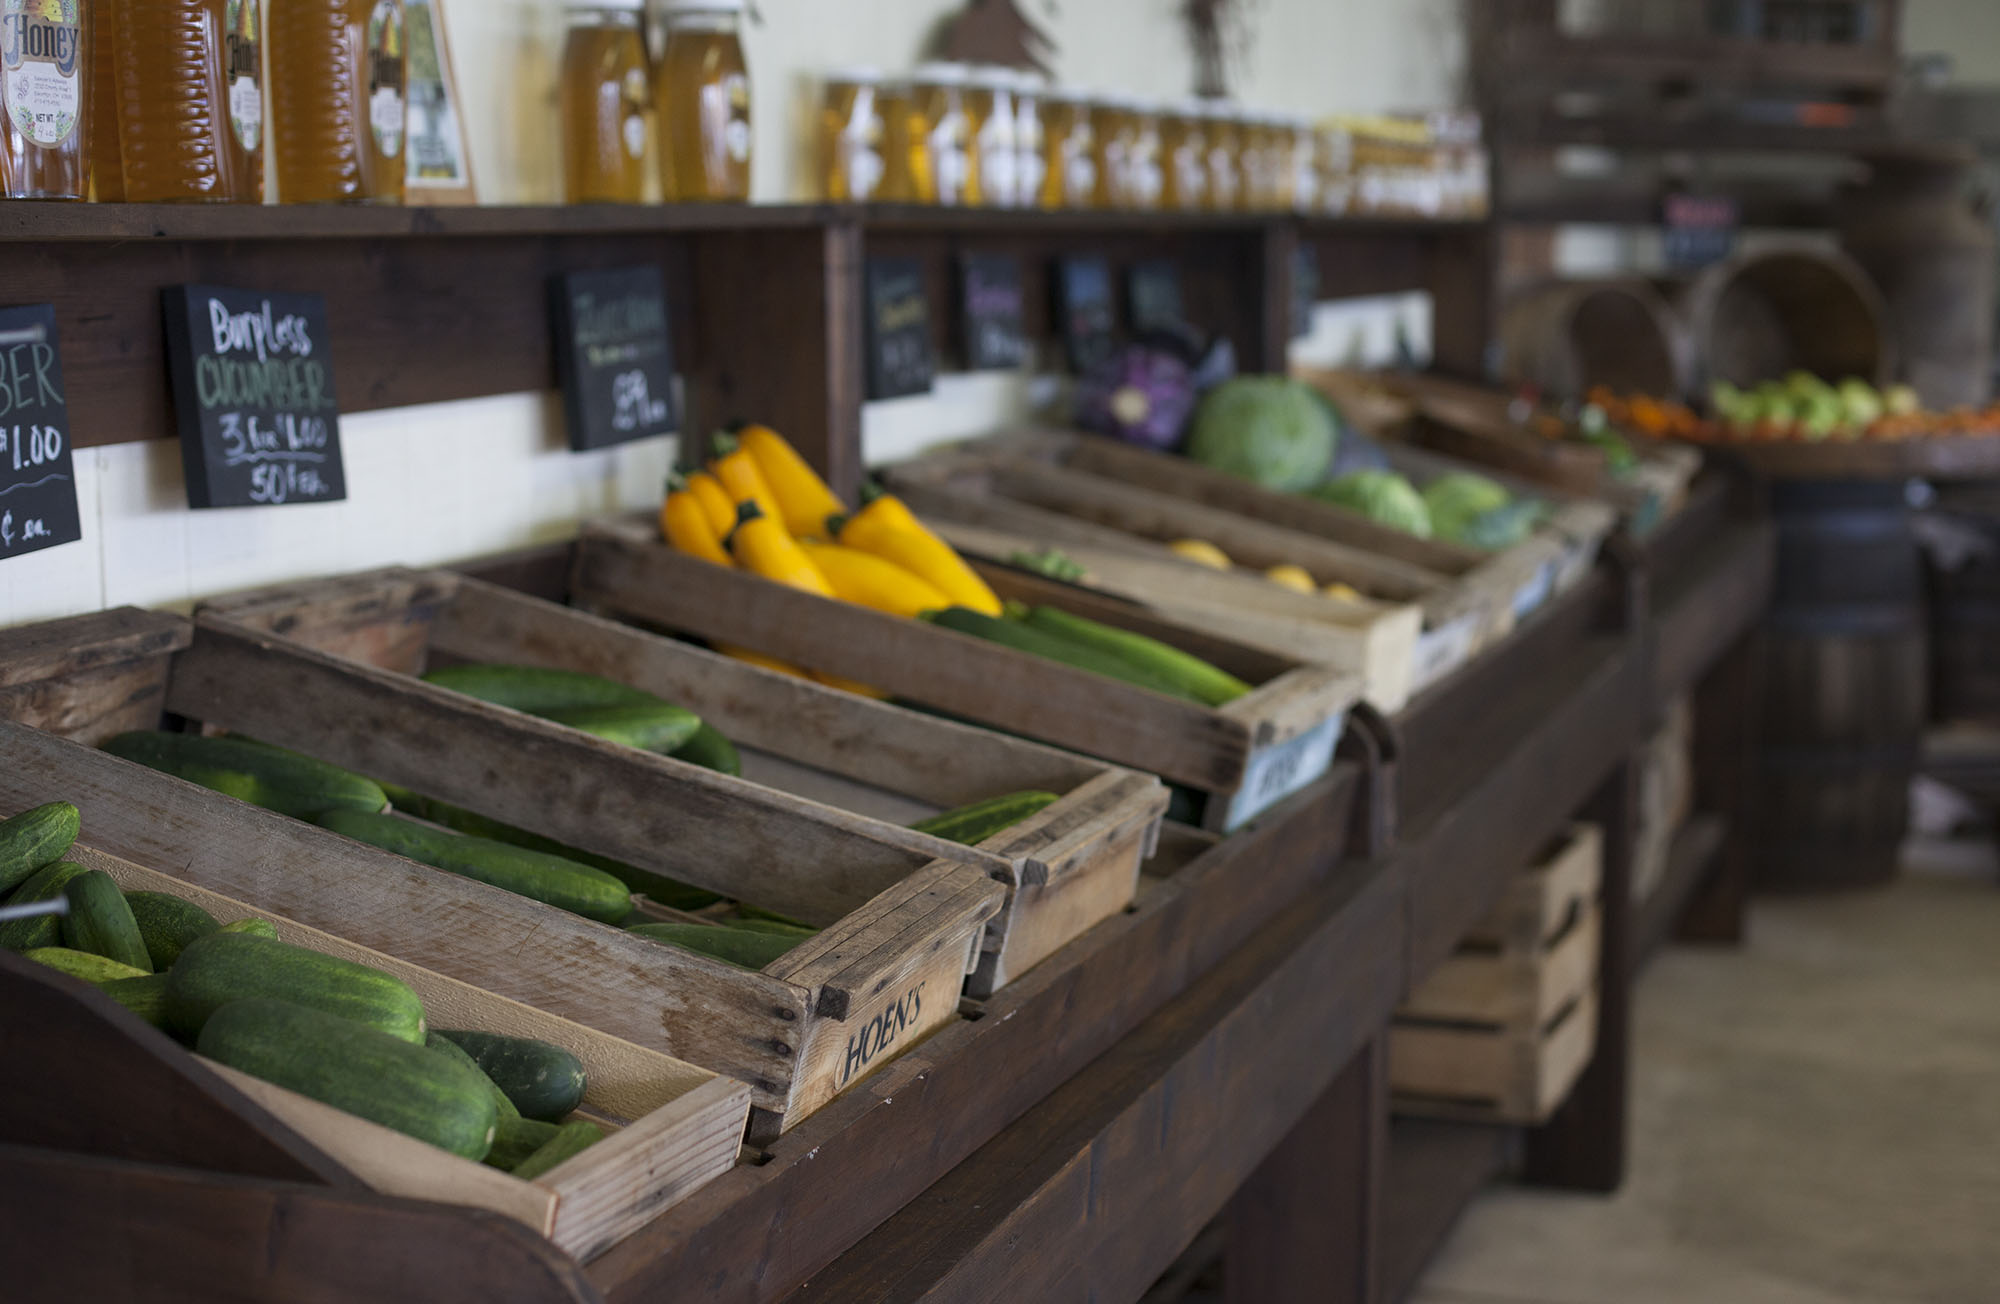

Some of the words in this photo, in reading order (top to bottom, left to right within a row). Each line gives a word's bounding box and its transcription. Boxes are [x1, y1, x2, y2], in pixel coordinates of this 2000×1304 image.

[3, 13, 79, 73] Honey
[209, 298, 312, 363] Burpless
[197, 354, 337, 410] CUCUMBER
[219, 413, 246, 456] 3
[842, 980, 926, 1086] HOEN'S
